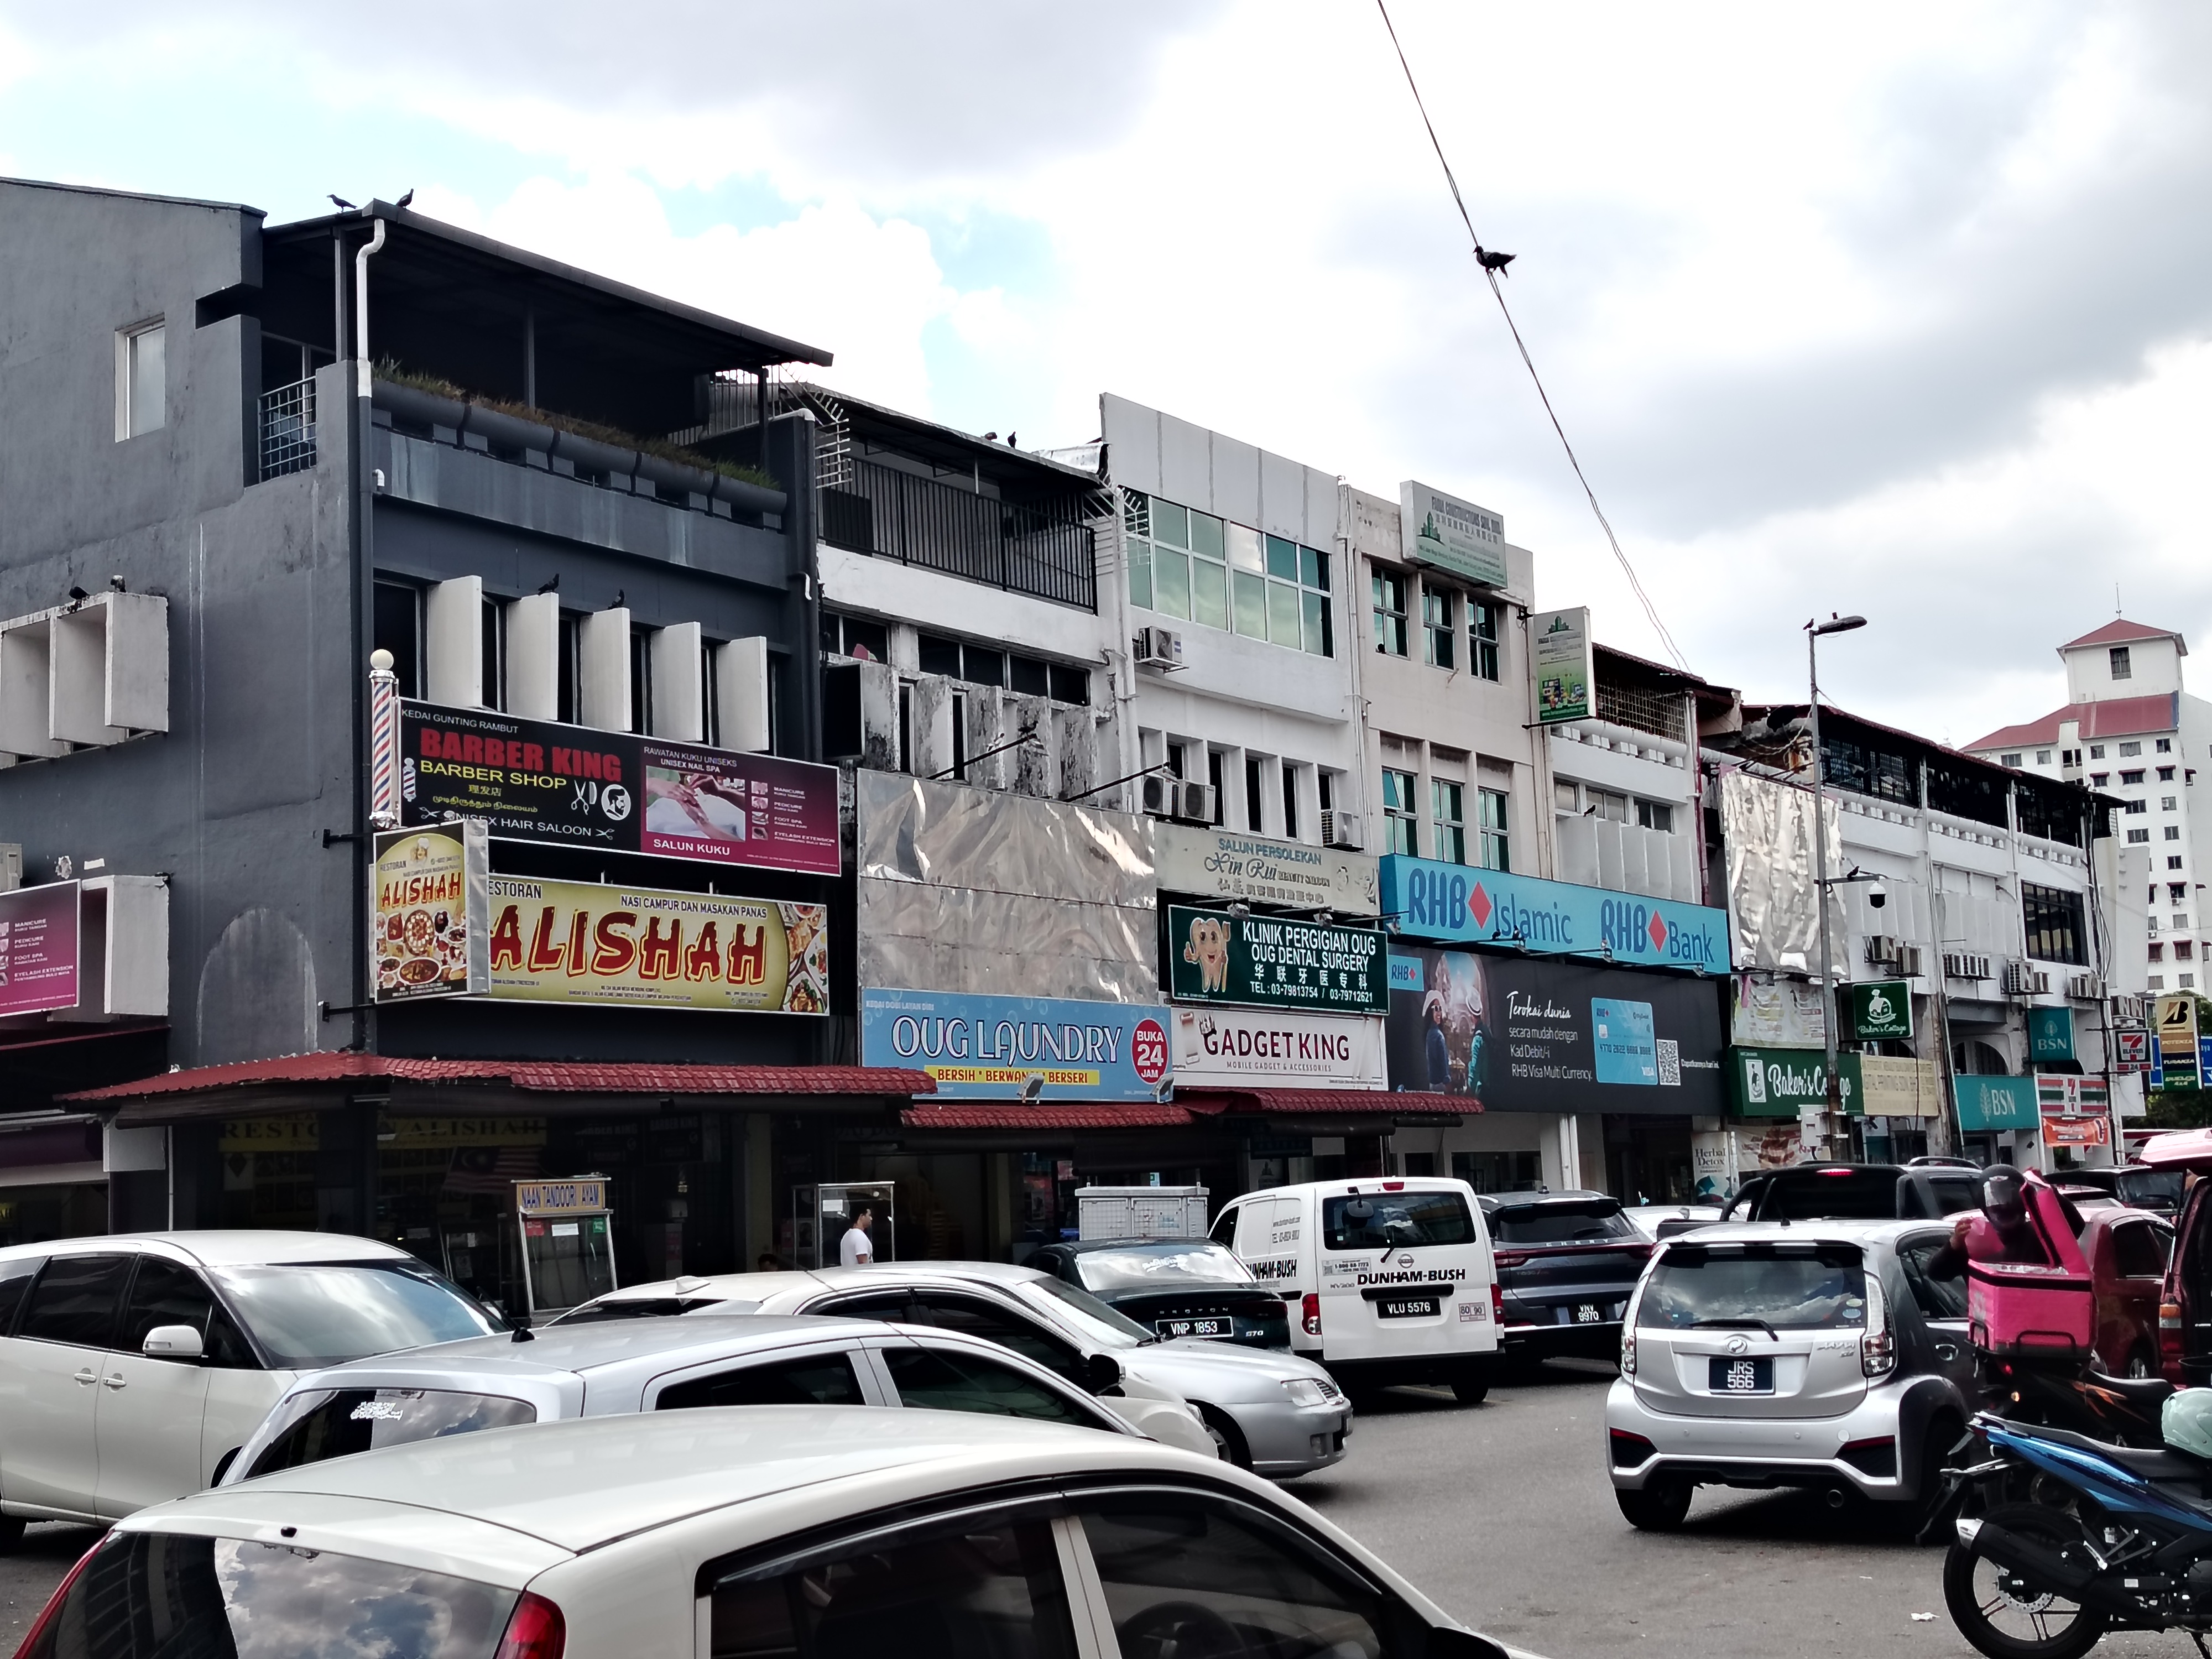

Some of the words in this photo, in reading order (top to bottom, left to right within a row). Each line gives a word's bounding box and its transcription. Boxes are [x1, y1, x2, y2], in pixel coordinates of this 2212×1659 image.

[401, 708, 431, 720] KEDAI
[433, 713, 477, 728] GUNTING
[479, 720, 518, 733] RAMBUT
[420, 728, 544, 771] BARBER
[552, 746, 622, 781] KING
[644, 746, 680, 759] RAWATAN
[681, 752, 702, 763] KUKU
[704, 756, 737, 768] UNISEKS
[660, 758, 687, 769] UNISEX
[688, 762, 705, 771] NAIL
[706, 764, 721, 773] SPA
[420, 760, 504, 783] BARBER
[510, 772, 567, 789] SHOP
[468, 784, 502, 797] 理发店
[500, 818, 533, 830] HAIR
[537, 822, 592, 836] SALOON
[654, 839, 693, 852] SALUN
[697, 844, 731, 855] KUKU
[1218, 838, 1255, 857] SALUN
[1256, 844, 1322, 865] PERSOLEKAN
[1246, 858, 1279, 882] Rui
[380, 872, 462, 910] ALISHAH
[488, 880, 542, 900] ESTORAN
[620, 895, 642, 908] NASI
[643, 897, 680, 911] CAMPUR
[681, 900, 698, 912] DAN
[700, 902, 740, 916] MASAKAN
[741, 906, 767, 919] PANAS
[1408, 868, 1467, 929] RHB
[1493, 893, 1573, 945] Islamic
[15, 919, 46, 927] MANICURE
[1601, 899, 1647, 953] RHB
[1668, 920, 1715, 962] Bank
[14, 936, 44, 944] PEDICURE
[490, 904, 768, 986] ALISHAH
[1243, 921, 1282, 946] KLINIK
[1286, 925, 1349, 952] PERGIGIAN
[1351, 935, 1376, 956] OUG
[1251, 944, 1275, 962] OUG
[1279, 946, 1320, 968] DENTAL
[1322, 951, 1369, 972] SURGERY
[14, 969, 41, 978] EYELASH
[42, 965, 74, 974] EXTENSION
[1391, 964, 1410, 981] RHB
[866, 1000, 885, 1009] KEDAI
[885, 1001, 901, 1009] DOBI
[902, 1002, 921, 1011] LAYAN
[1506, 990, 1543, 1020] Terokai
[1544, 999, 1572, 1019] dunia
[1136, 1030, 1164, 1043] BUKA
[1509, 1026, 1531, 1038] secara
[1531, 1026, 1554, 1040] mudah
[1554, 1027, 1578, 1044] dengan
[1858, 1025, 1884, 1034] Baker's
[891, 1015, 969, 1060] OUG
[977, 1019, 1123, 1068] LAUNDRY
[1203, 1027, 1293, 1058] GADGET
[1298, 1032, 1350, 1061] KING
[2038, 1038, 2067, 1051] BSN
[1137, 1045, 1165, 1067] 24
[1510, 1044, 1524, 1057] Kad
[1140, 1068, 1160, 1079] JAM
[1227, 1061, 1252, 1070] MOBILE
[1254, 1062, 1281, 1071] GADGET
[1290, 1063, 1332, 1072] ACCESSORIES
[1511, 1063, 1528, 1078] RHB
[1528, 1064, 1543, 1078] Visa
[1543, 1065, 1561, 1079] Multi
[1562, 1066, 1593, 1082] Currency.
[937, 1068, 975, 1082] BERSIH
[1048, 1072, 1088, 1084] BERSERI
[1767, 1063, 1814, 1098] Baker's
[1991, 1089, 2016, 1115] BSN
[411, 1119, 539, 1136] ALISHAH
[1695, 1147, 1726, 1157] Herbal
[1697, 1157, 1725, 1166] Detox
[521, 1186, 541, 1209] NAAN
[582, 1183, 599, 1207] AYAM
[1357, 1268, 1465, 1285] DUNHAM-BUSH
[1387, 1303, 1405, 1314] VLU
[1407, 1302, 1431, 1313] 5576
[1460, 1305, 1470, 1314] 80
[1473, 1306, 1483, 1314] 90
[1578, 1311, 1599, 1322] 8970
[1170, 1322, 1190, 1335] VNP
[1194, 1321, 1218, 1334] 1853
[1728, 1361, 1754, 1374] JRS
[1727, 1374, 1754, 1389] 566
